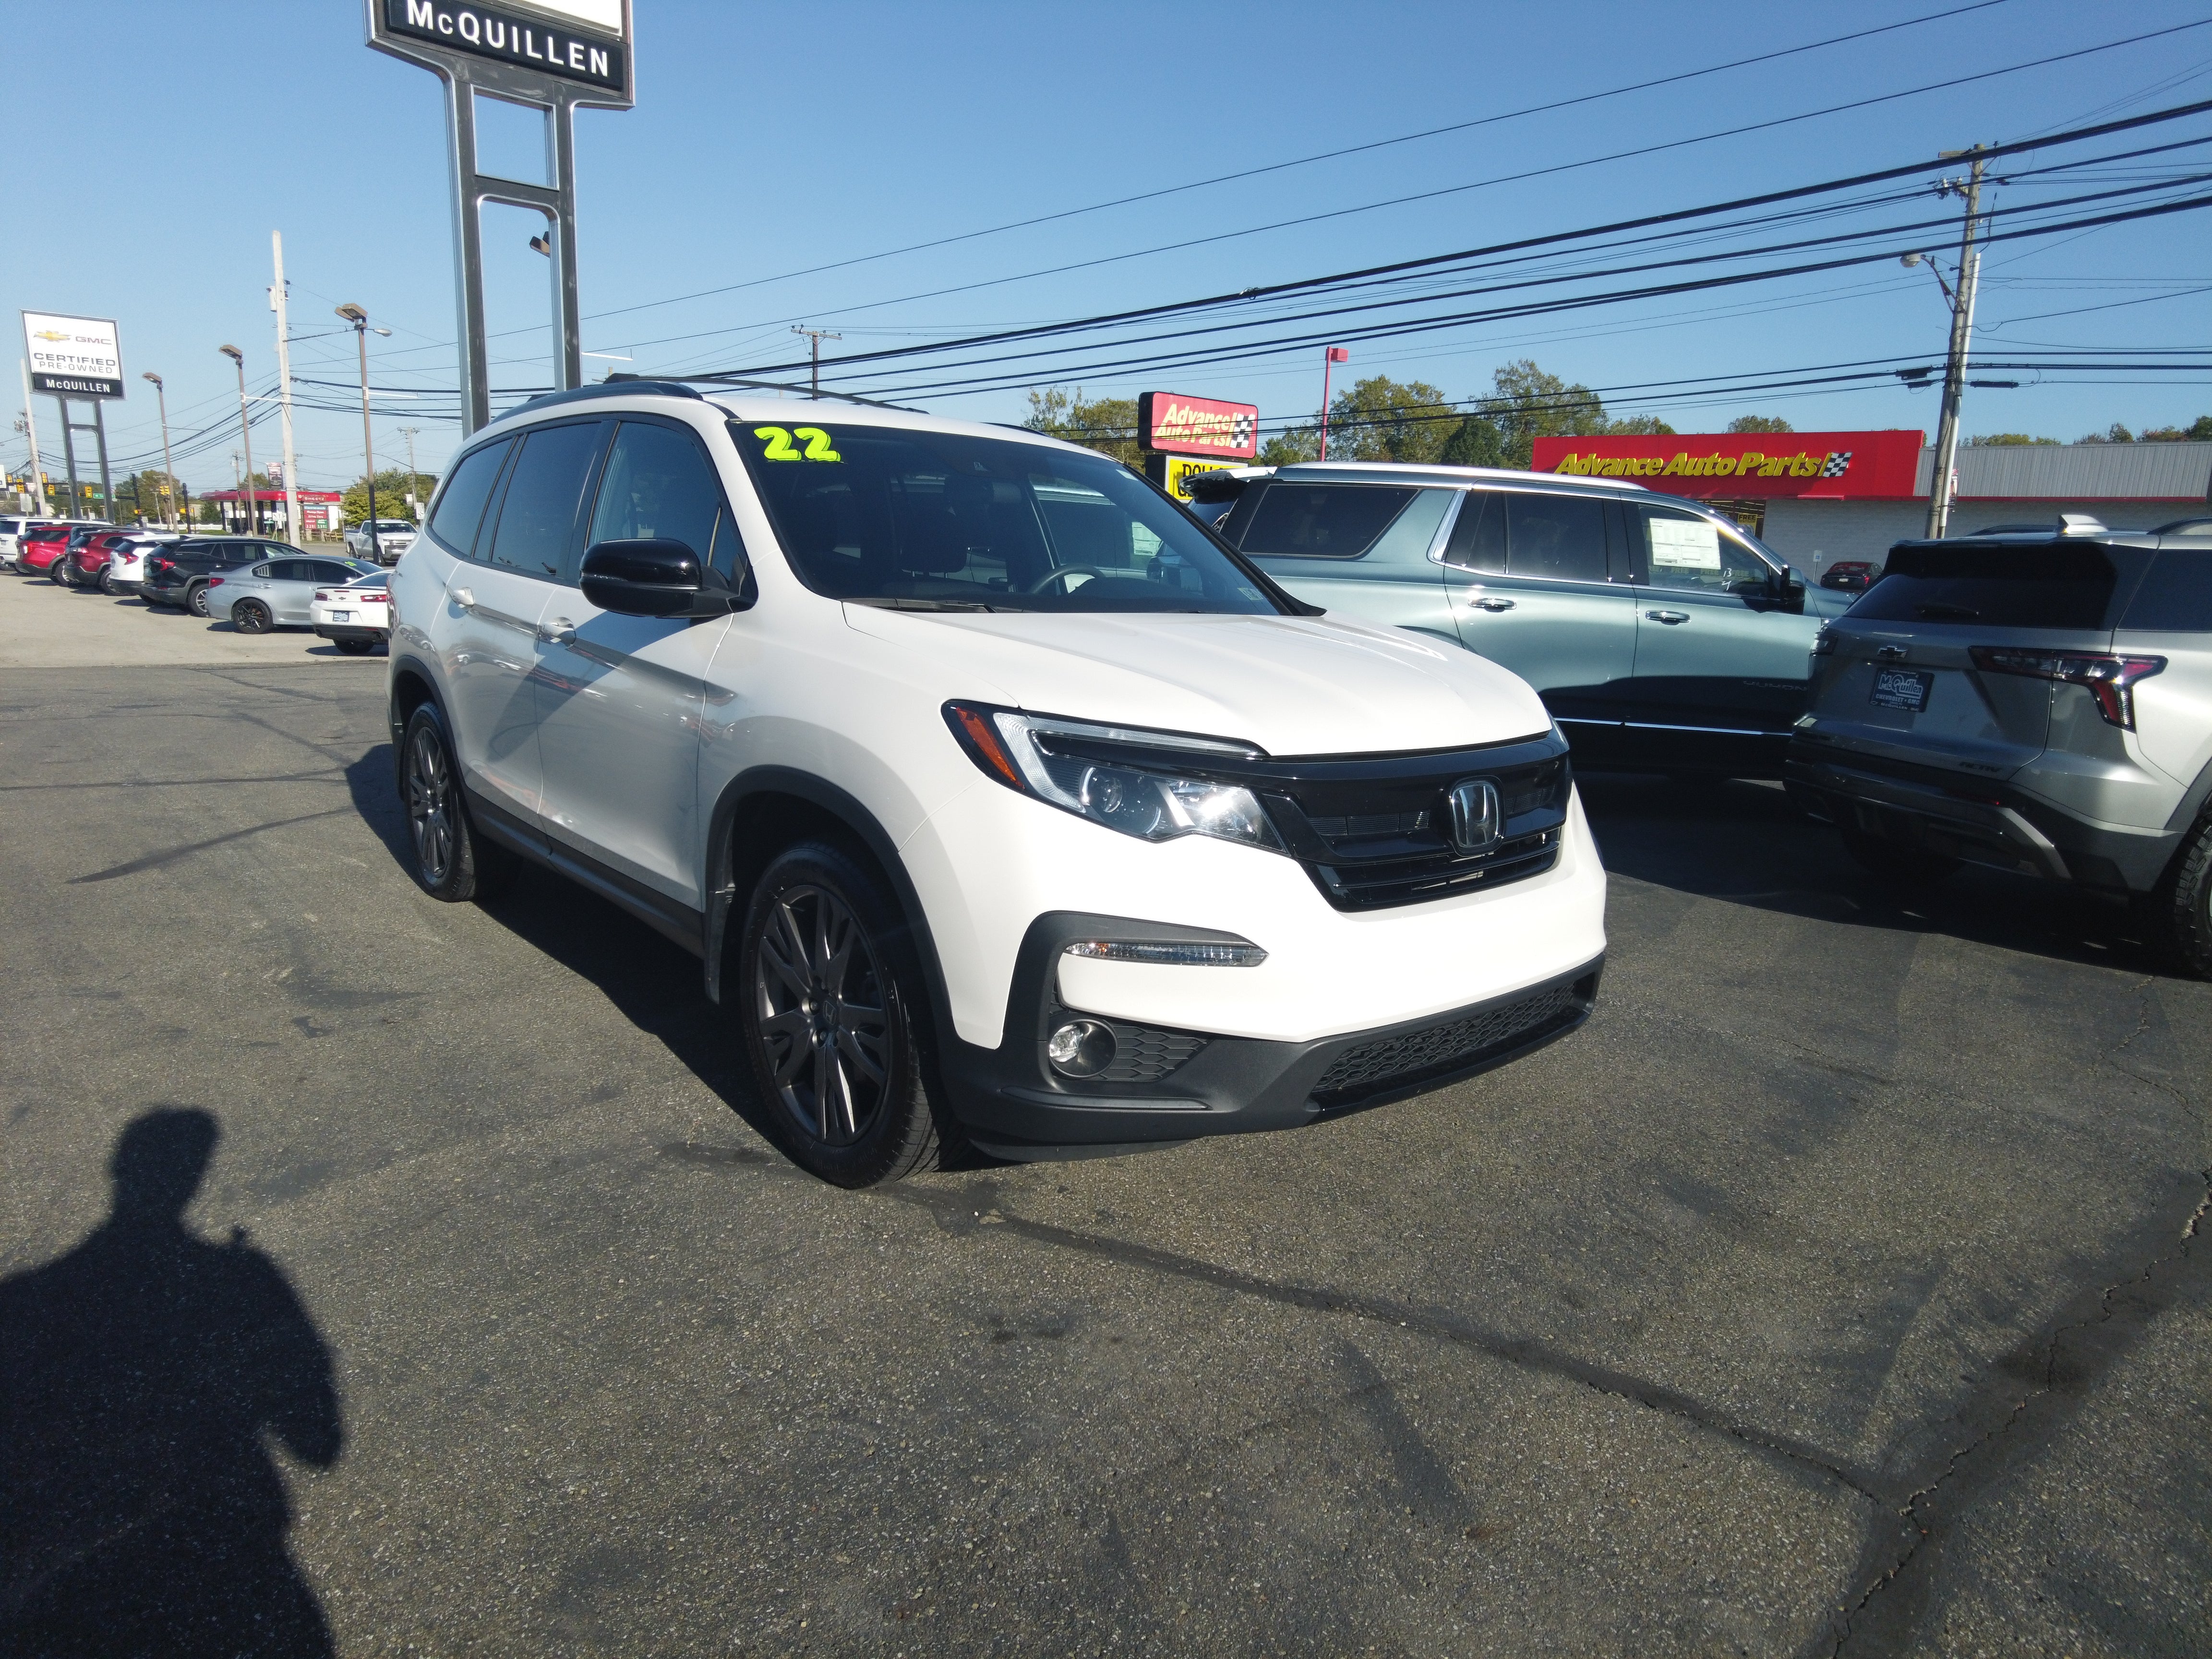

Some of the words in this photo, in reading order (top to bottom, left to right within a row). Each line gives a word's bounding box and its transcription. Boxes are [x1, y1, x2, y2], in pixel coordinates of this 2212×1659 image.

[408, 0, 608, 77] McQUILLEN
[75, 336, 112, 345] GMC
[34, 352, 116, 366] CERTIFIED
[39, 361, 112, 373] PRE-OWNED
[46, 379, 110, 393] McQUILLEN
[1163, 404, 1230, 431] Advance
[754, 426, 841, 462] 22
[1154, 422, 1190, 443] Auto
[1190, 426, 1227, 446] Parts
[1554, 453, 1664, 476] Advance
[1661, 452, 1736, 476] Auto
[1734, 452, 1822, 477] Parts
[1875, 693, 1904, 703] CHEVROLET
[1878, 674, 1923, 699] McQuillen
